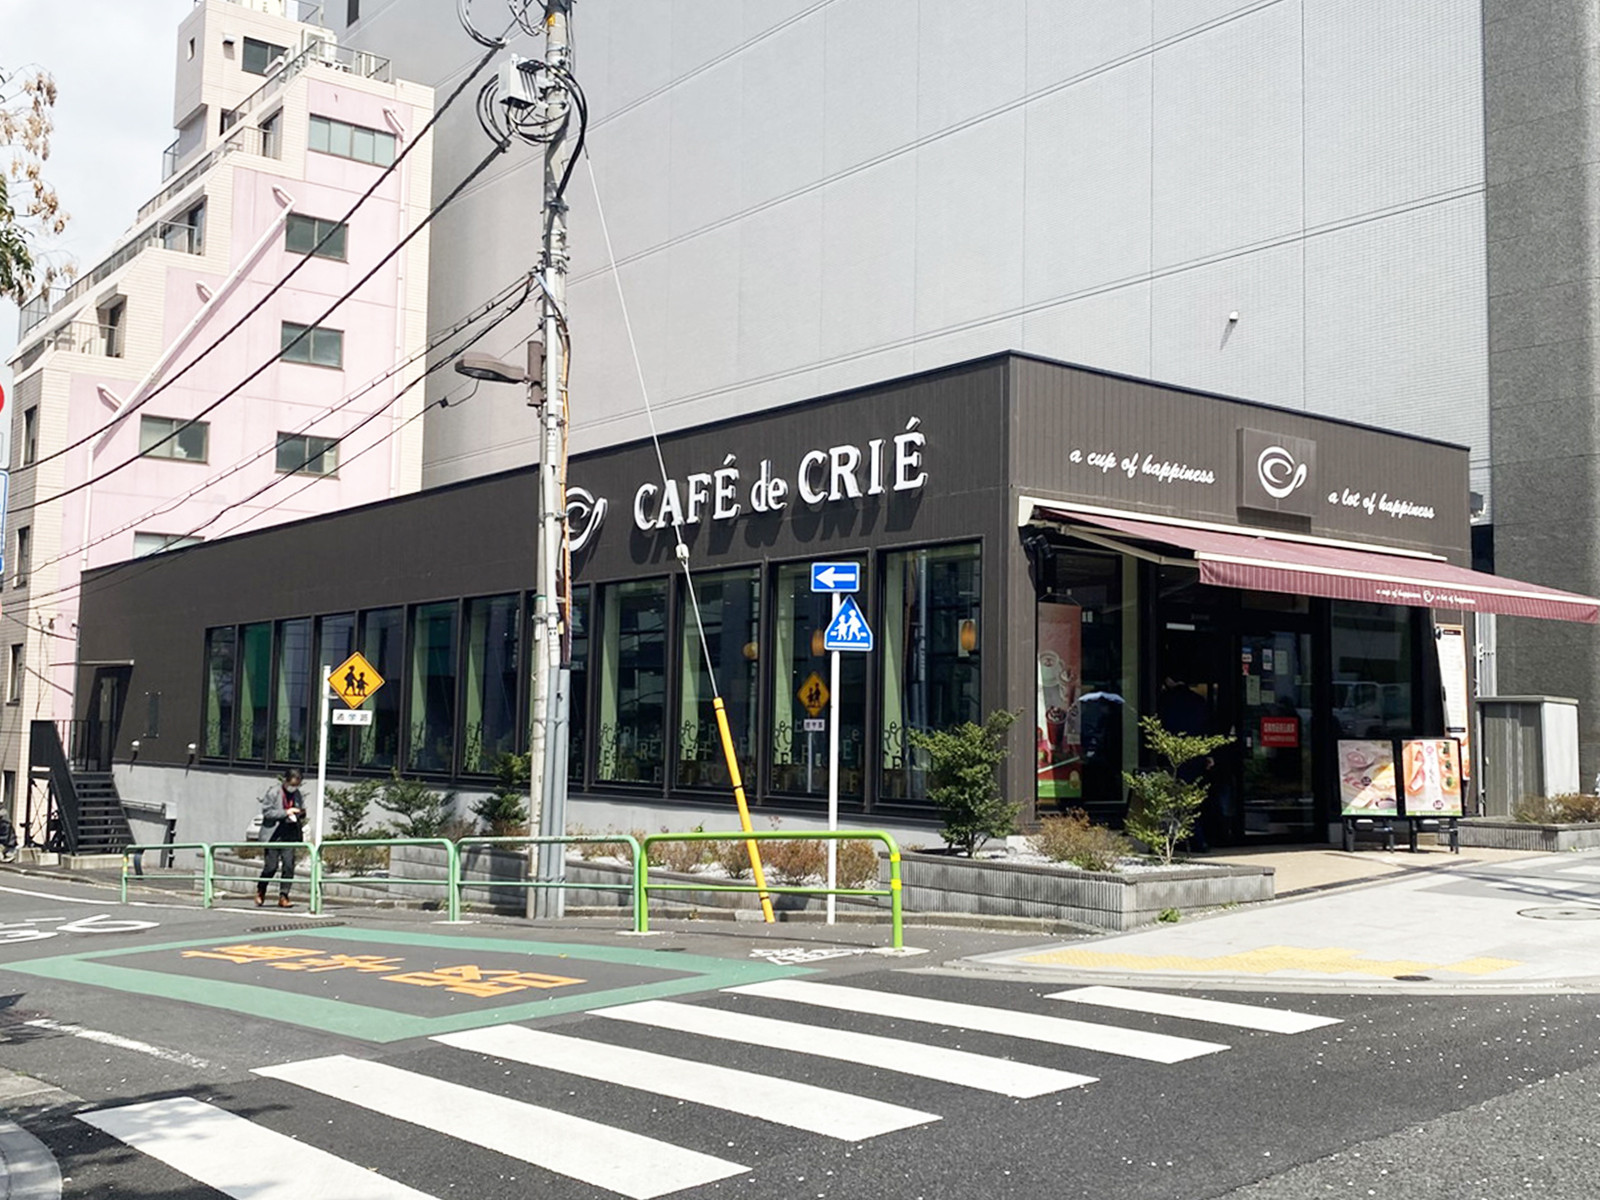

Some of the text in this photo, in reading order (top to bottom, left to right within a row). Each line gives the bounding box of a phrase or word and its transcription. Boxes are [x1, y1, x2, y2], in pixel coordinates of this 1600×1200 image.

[633, 416, 928, 530] CAFÉ de CRIÉ
[1069, 449, 1215, 484] a cup of happiness
[1328, 488, 1435, 519] a lot of happiness
